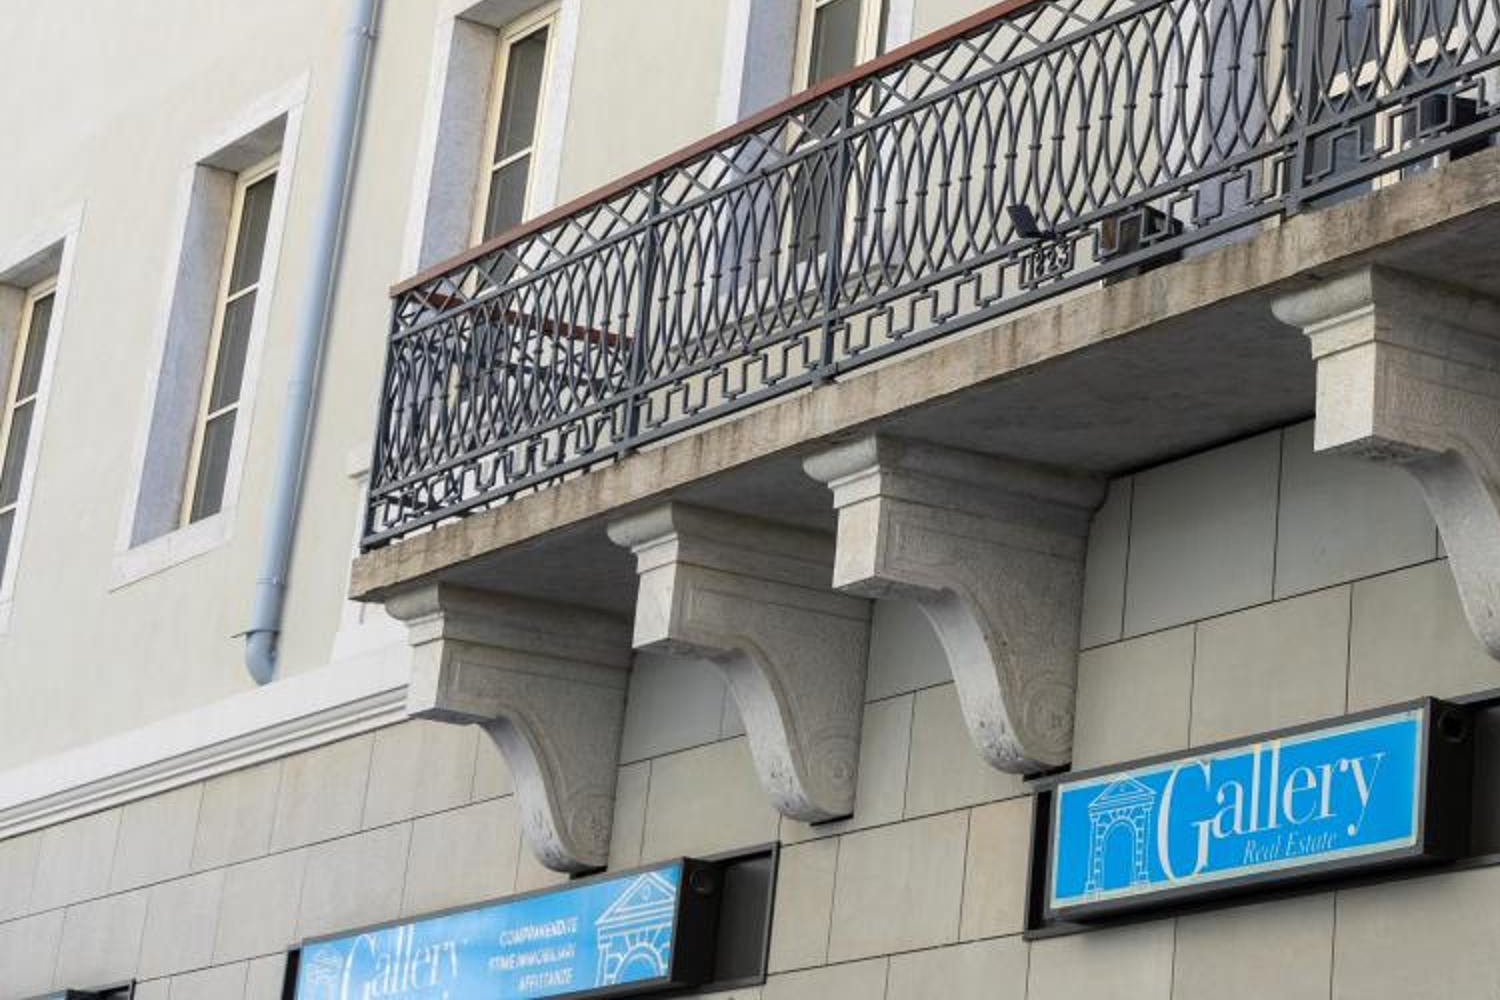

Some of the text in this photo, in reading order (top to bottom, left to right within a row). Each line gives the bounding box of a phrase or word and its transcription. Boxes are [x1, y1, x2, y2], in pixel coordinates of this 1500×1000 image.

[1157, 740, 1387, 883] Gallery
[1242, 830, 1338, 865] Real Estate
